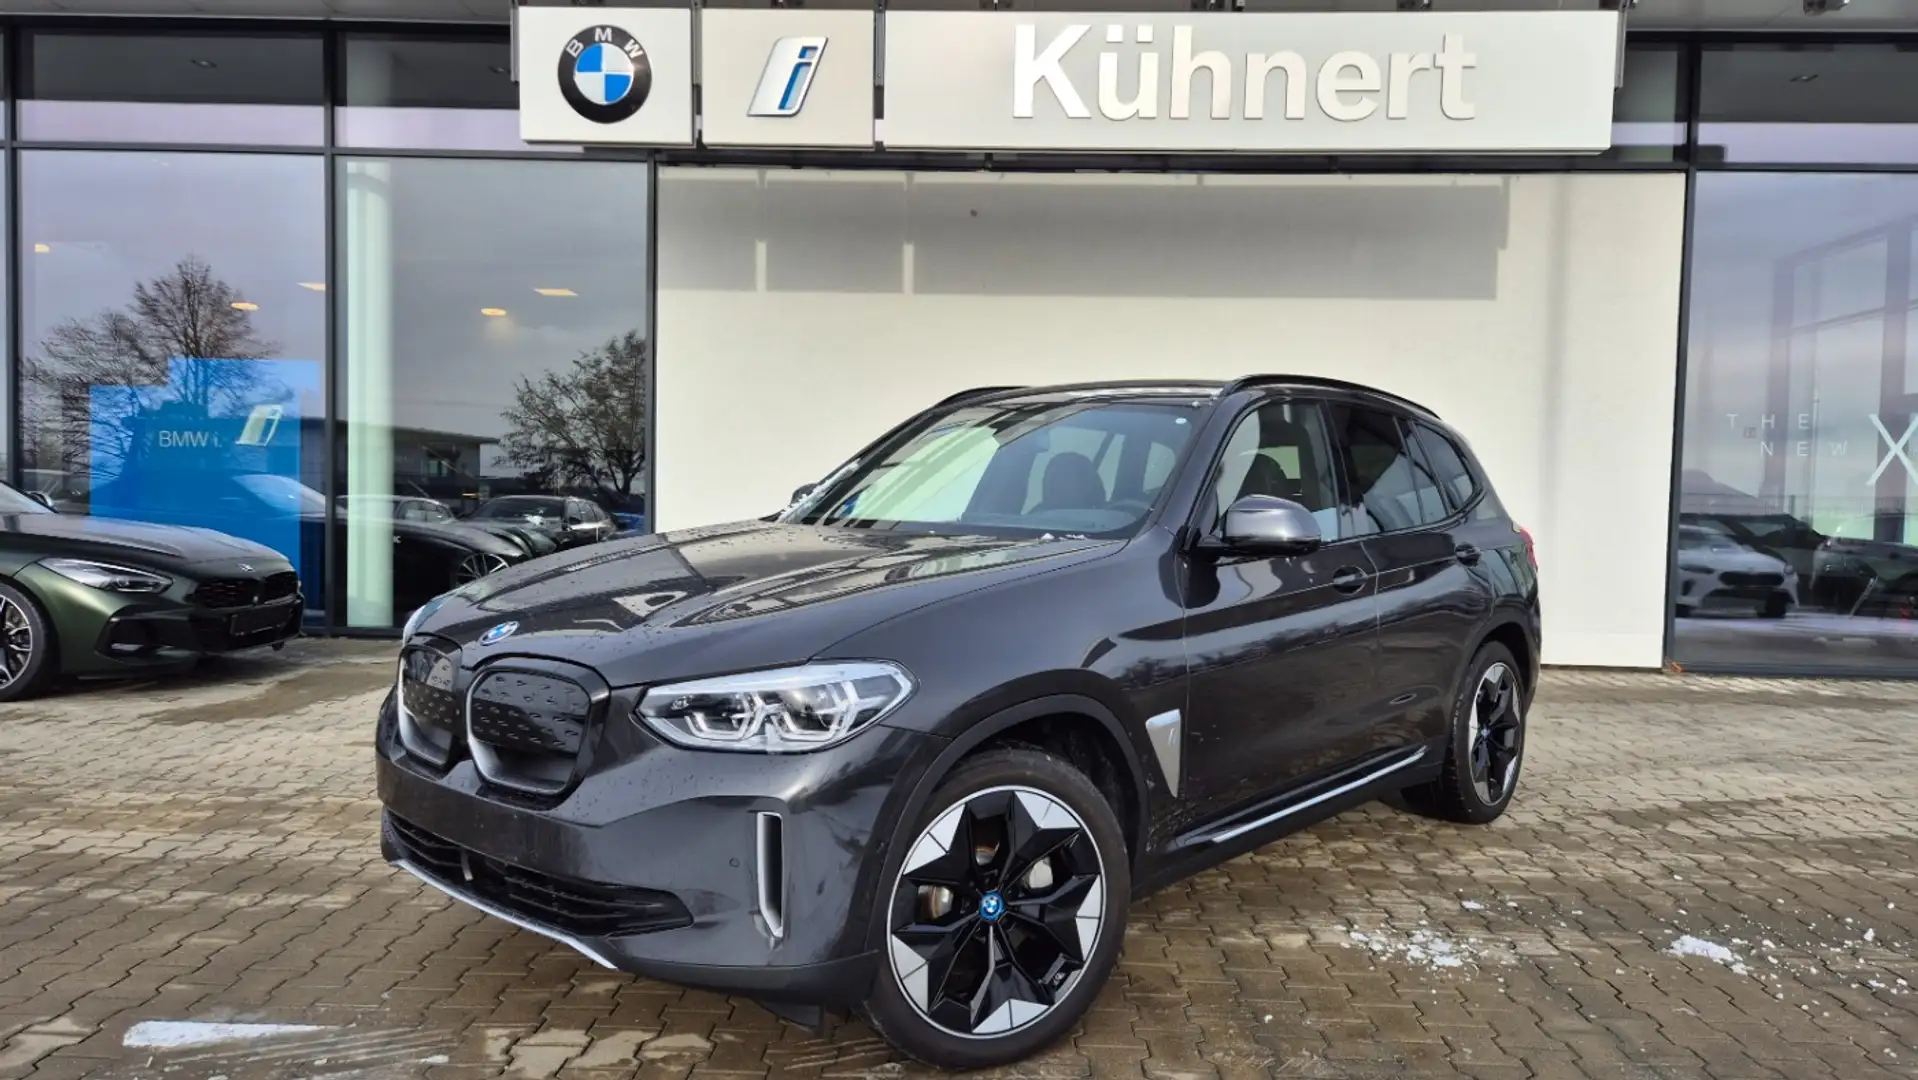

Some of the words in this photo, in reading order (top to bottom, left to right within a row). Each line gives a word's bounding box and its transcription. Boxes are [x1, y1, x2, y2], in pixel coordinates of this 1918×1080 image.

[566, 27, 644, 59] BMW
[1012, 23, 1477, 122] Kühnert
[1726, 413, 1810, 430] THE
[159, 430, 209, 448] BMW
[1760, 441, 1848, 456] NEW
